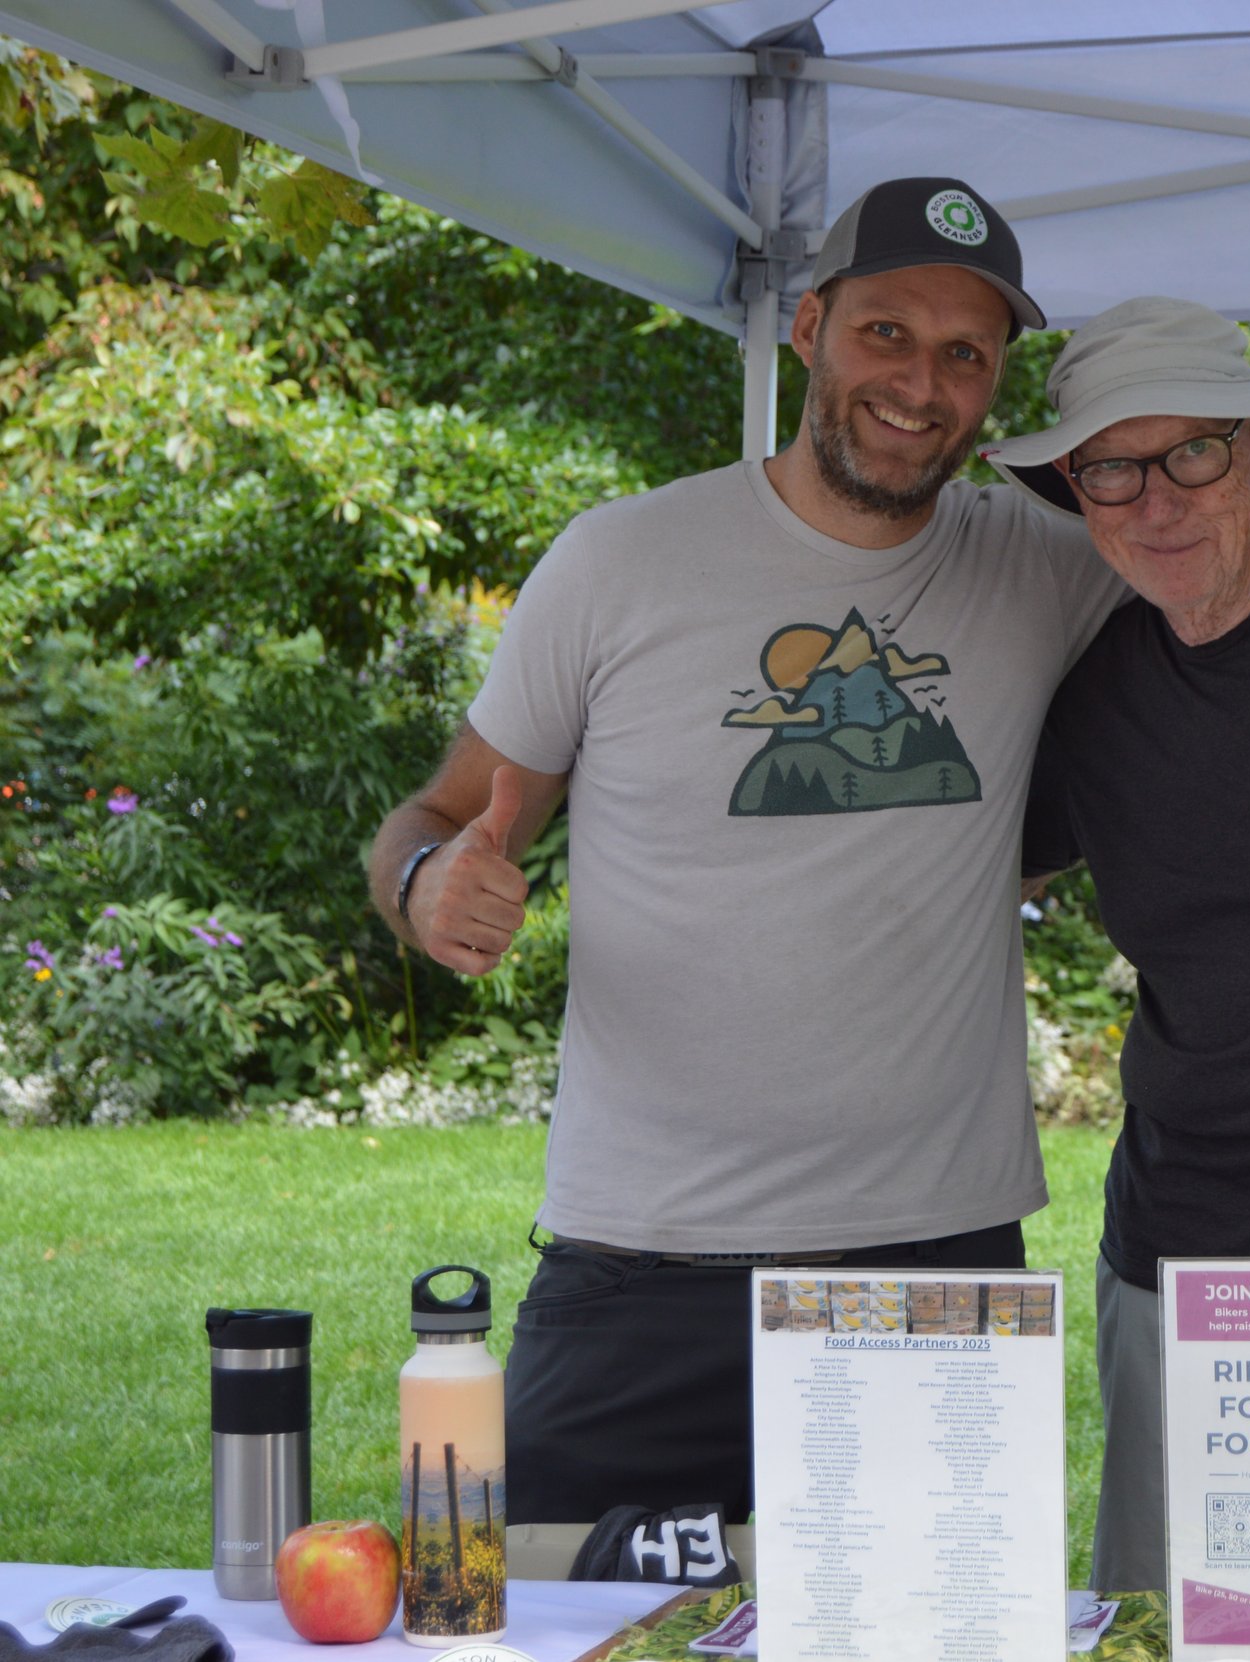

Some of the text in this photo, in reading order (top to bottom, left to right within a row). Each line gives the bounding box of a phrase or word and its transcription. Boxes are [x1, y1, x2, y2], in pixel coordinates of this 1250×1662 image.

[931, 194, 984, 225] BOSTON AREA
[933, 217, 982, 241] GLEANERS
[1215, 1307, 1248, 1317] Bikers
[1209, 1322, 1232, 1332] help
[825, 1336, 991, 1350] Food Access Partners 2025
[1195, 1585, 1212, 1596] Bike
[1228, 1592, 1238, 1601] 50
